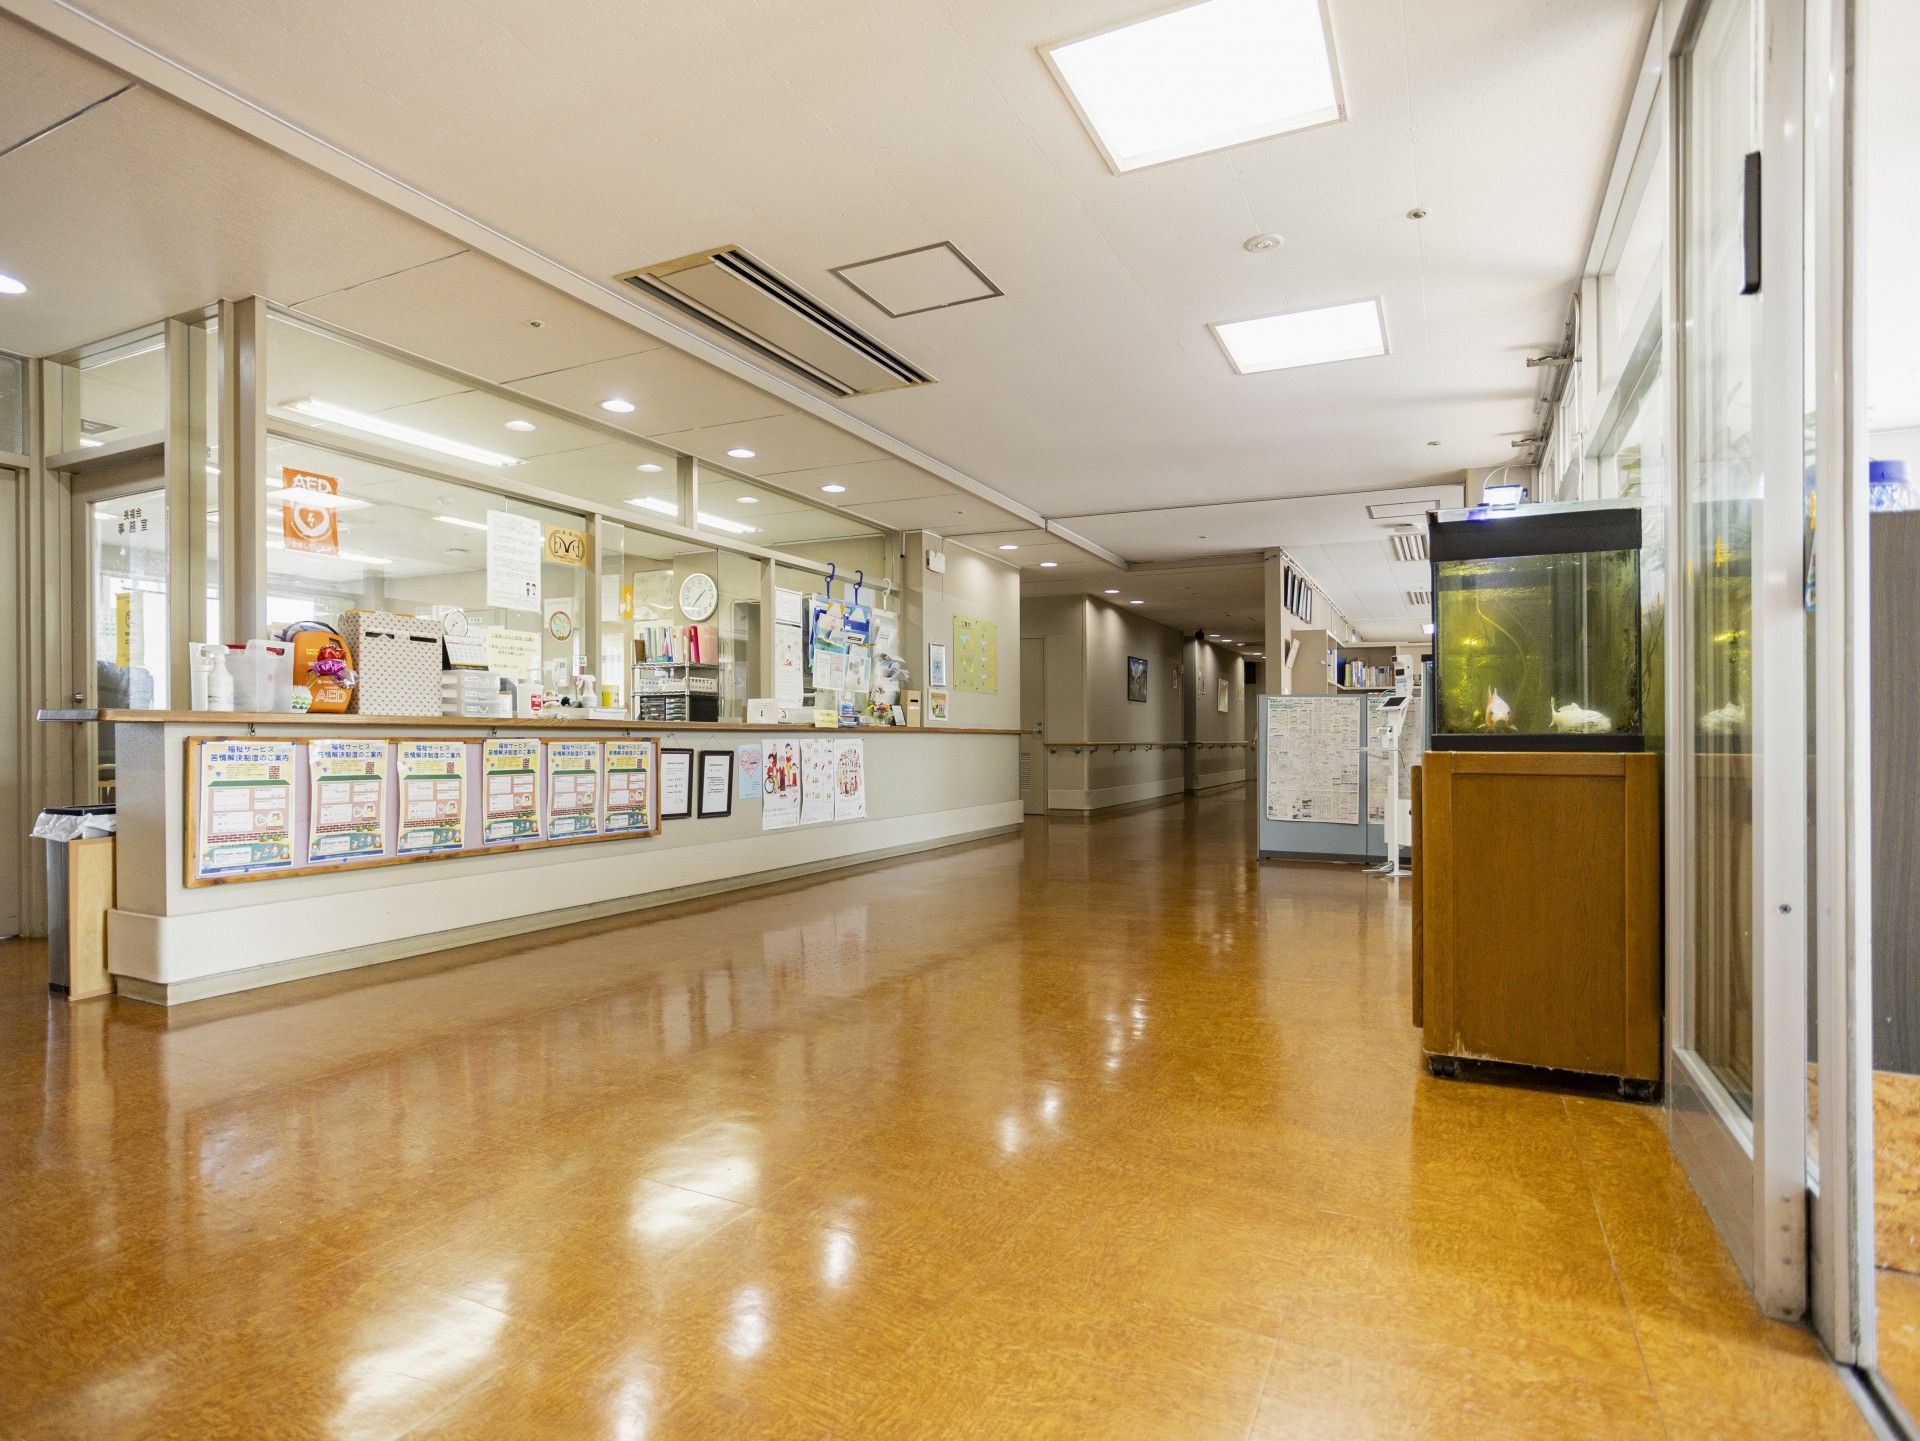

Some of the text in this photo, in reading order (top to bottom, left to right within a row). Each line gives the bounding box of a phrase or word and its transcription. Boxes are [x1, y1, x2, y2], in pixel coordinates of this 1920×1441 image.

[315, 689, 347, 703] AED
[227, 745, 274, 753] 福祉サービス
[210, 753, 289, 762] 苦情解決制度のご案内
